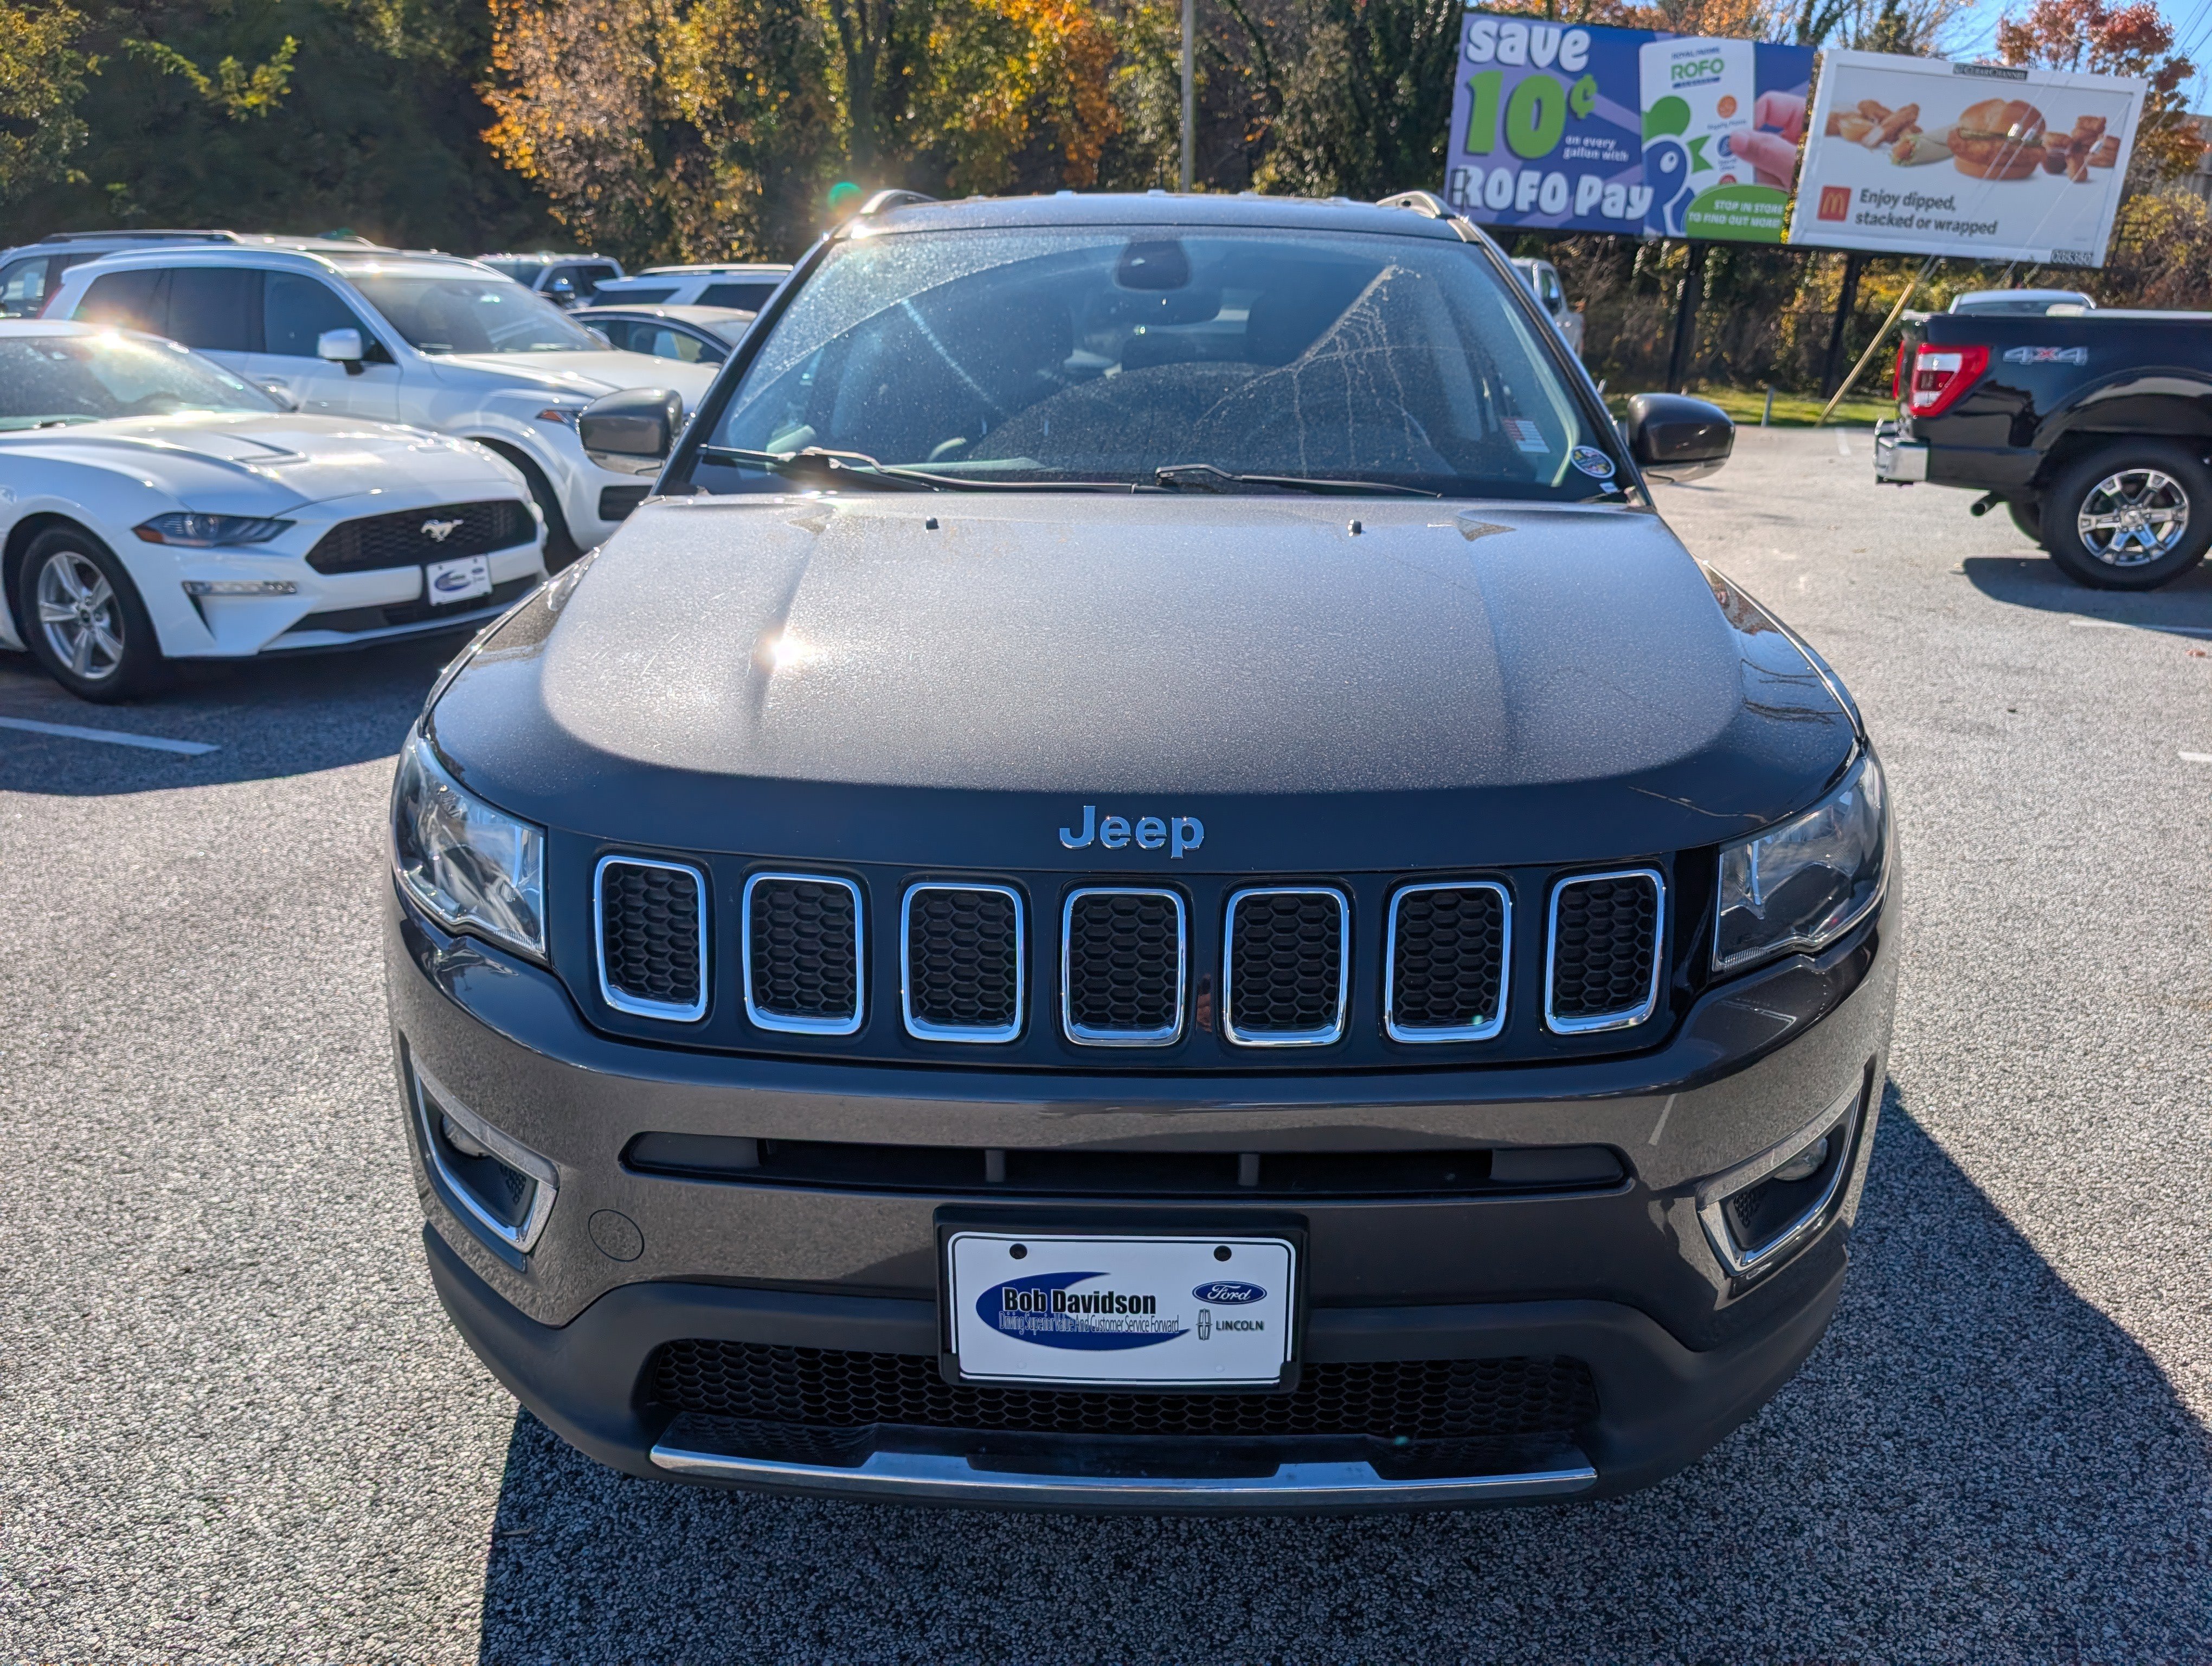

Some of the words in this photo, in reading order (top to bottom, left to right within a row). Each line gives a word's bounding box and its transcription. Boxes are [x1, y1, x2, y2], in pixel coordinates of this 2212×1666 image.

[1671, 57, 1725, 80] ROFO
[1562, 146, 1600, 160] gallon
[1602, 150, 1629, 162] with
[1565, 136, 1581, 145] on
[1583, 137, 1617, 152] every
[1452, 165, 1568, 215] ROFO
[1574, 174, 1654, 220] Pay
[1859, 188, 1899, 209] Enjoy
[1902, 191, 1957, 213] dipped,
[1689, 212, 1702, 223] TO
[1702, 213, 1728, 225] FIND
[1728, 215, 1749, 226] OUT
[1714, 200, 1739, 211] STOP
[1740, 202, 1752, 213] IN
[1754, 203, 1783, 215] STORE
[1855, 212, 1915, 228] stacked
[1916, 217, 1932, 230] or
[1934, 220, 1999, 238] wrapped
[1059, 805, 1205, 859] Jeep
[1003, 1287, 1047, 1313] Bob
[1051, 1289, 1156, 1315] Davidson
[1207, 1284, 1252, 1300] Ford
[999, 1311, 1024, 1335] Driving
[1025, 1312, 1054, 1335] Superior
[1054, 1313, 1075, 1332] Value
[1075, 1313, 1089, 1332] And
[1090, 1314, 1124, 1332] Customer
[1125, 1315, 1149, 1333] Service
[1150, 1315, 1179, 1333] Forward
[1216, 1320, 1264, 1331] LINCOLN
